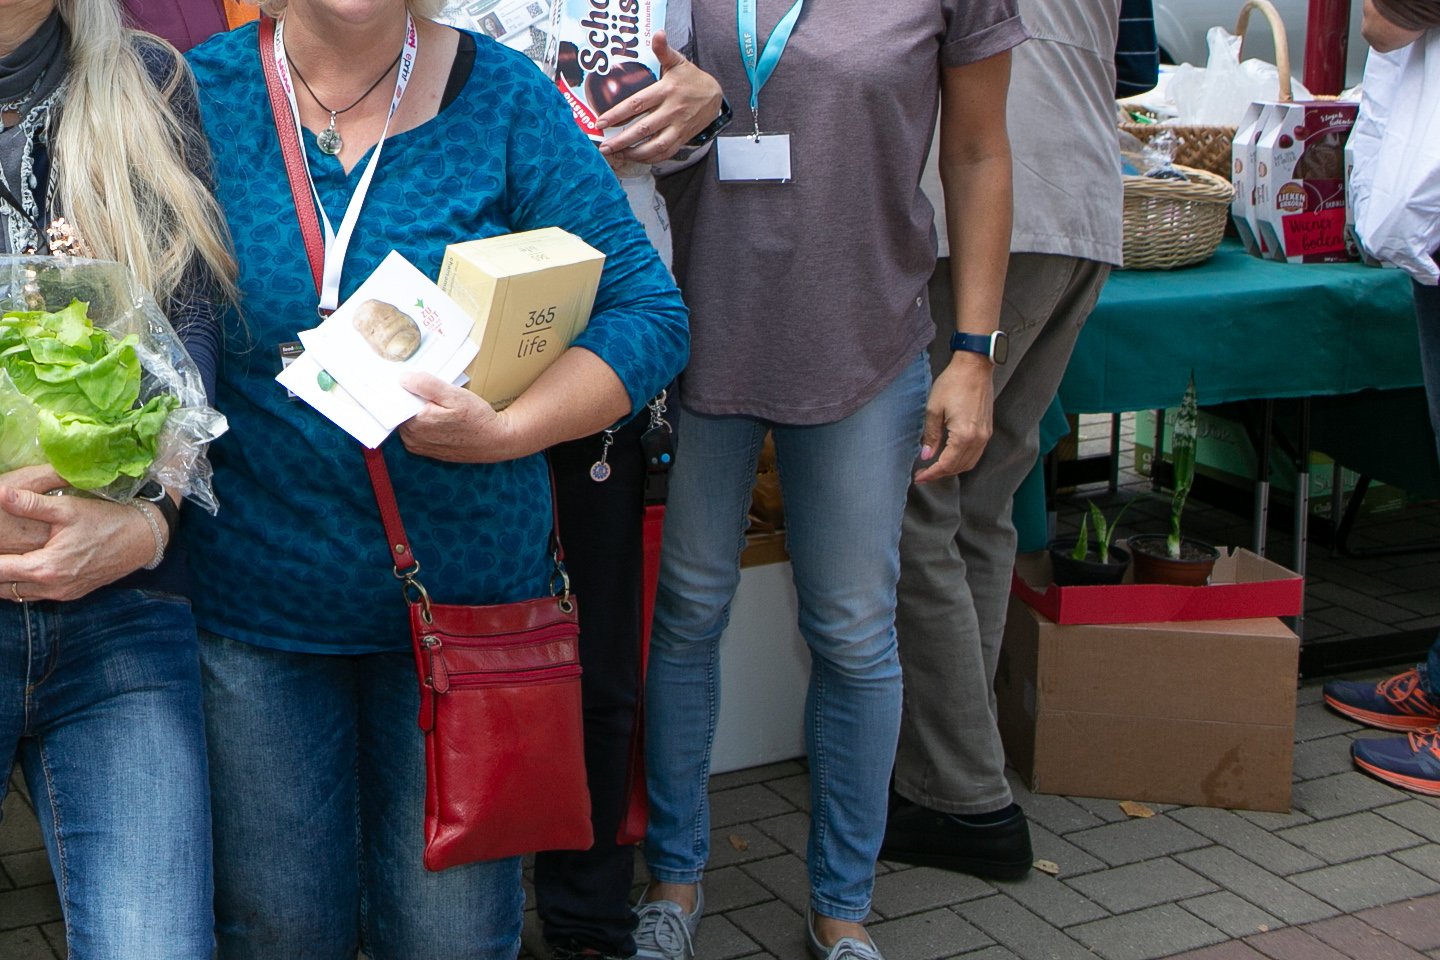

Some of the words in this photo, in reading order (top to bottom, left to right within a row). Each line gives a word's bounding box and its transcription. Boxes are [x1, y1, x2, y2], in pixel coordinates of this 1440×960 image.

[743, 32, 754, 55] ISTAF
[1278, 193, 1306, 203] LIEKEN
[420, 306, 432, 319] ZU
[422, 310, 439, 327] GUT
[525, 306, 557, 328] 365
[517, 335, 548, 358] life
